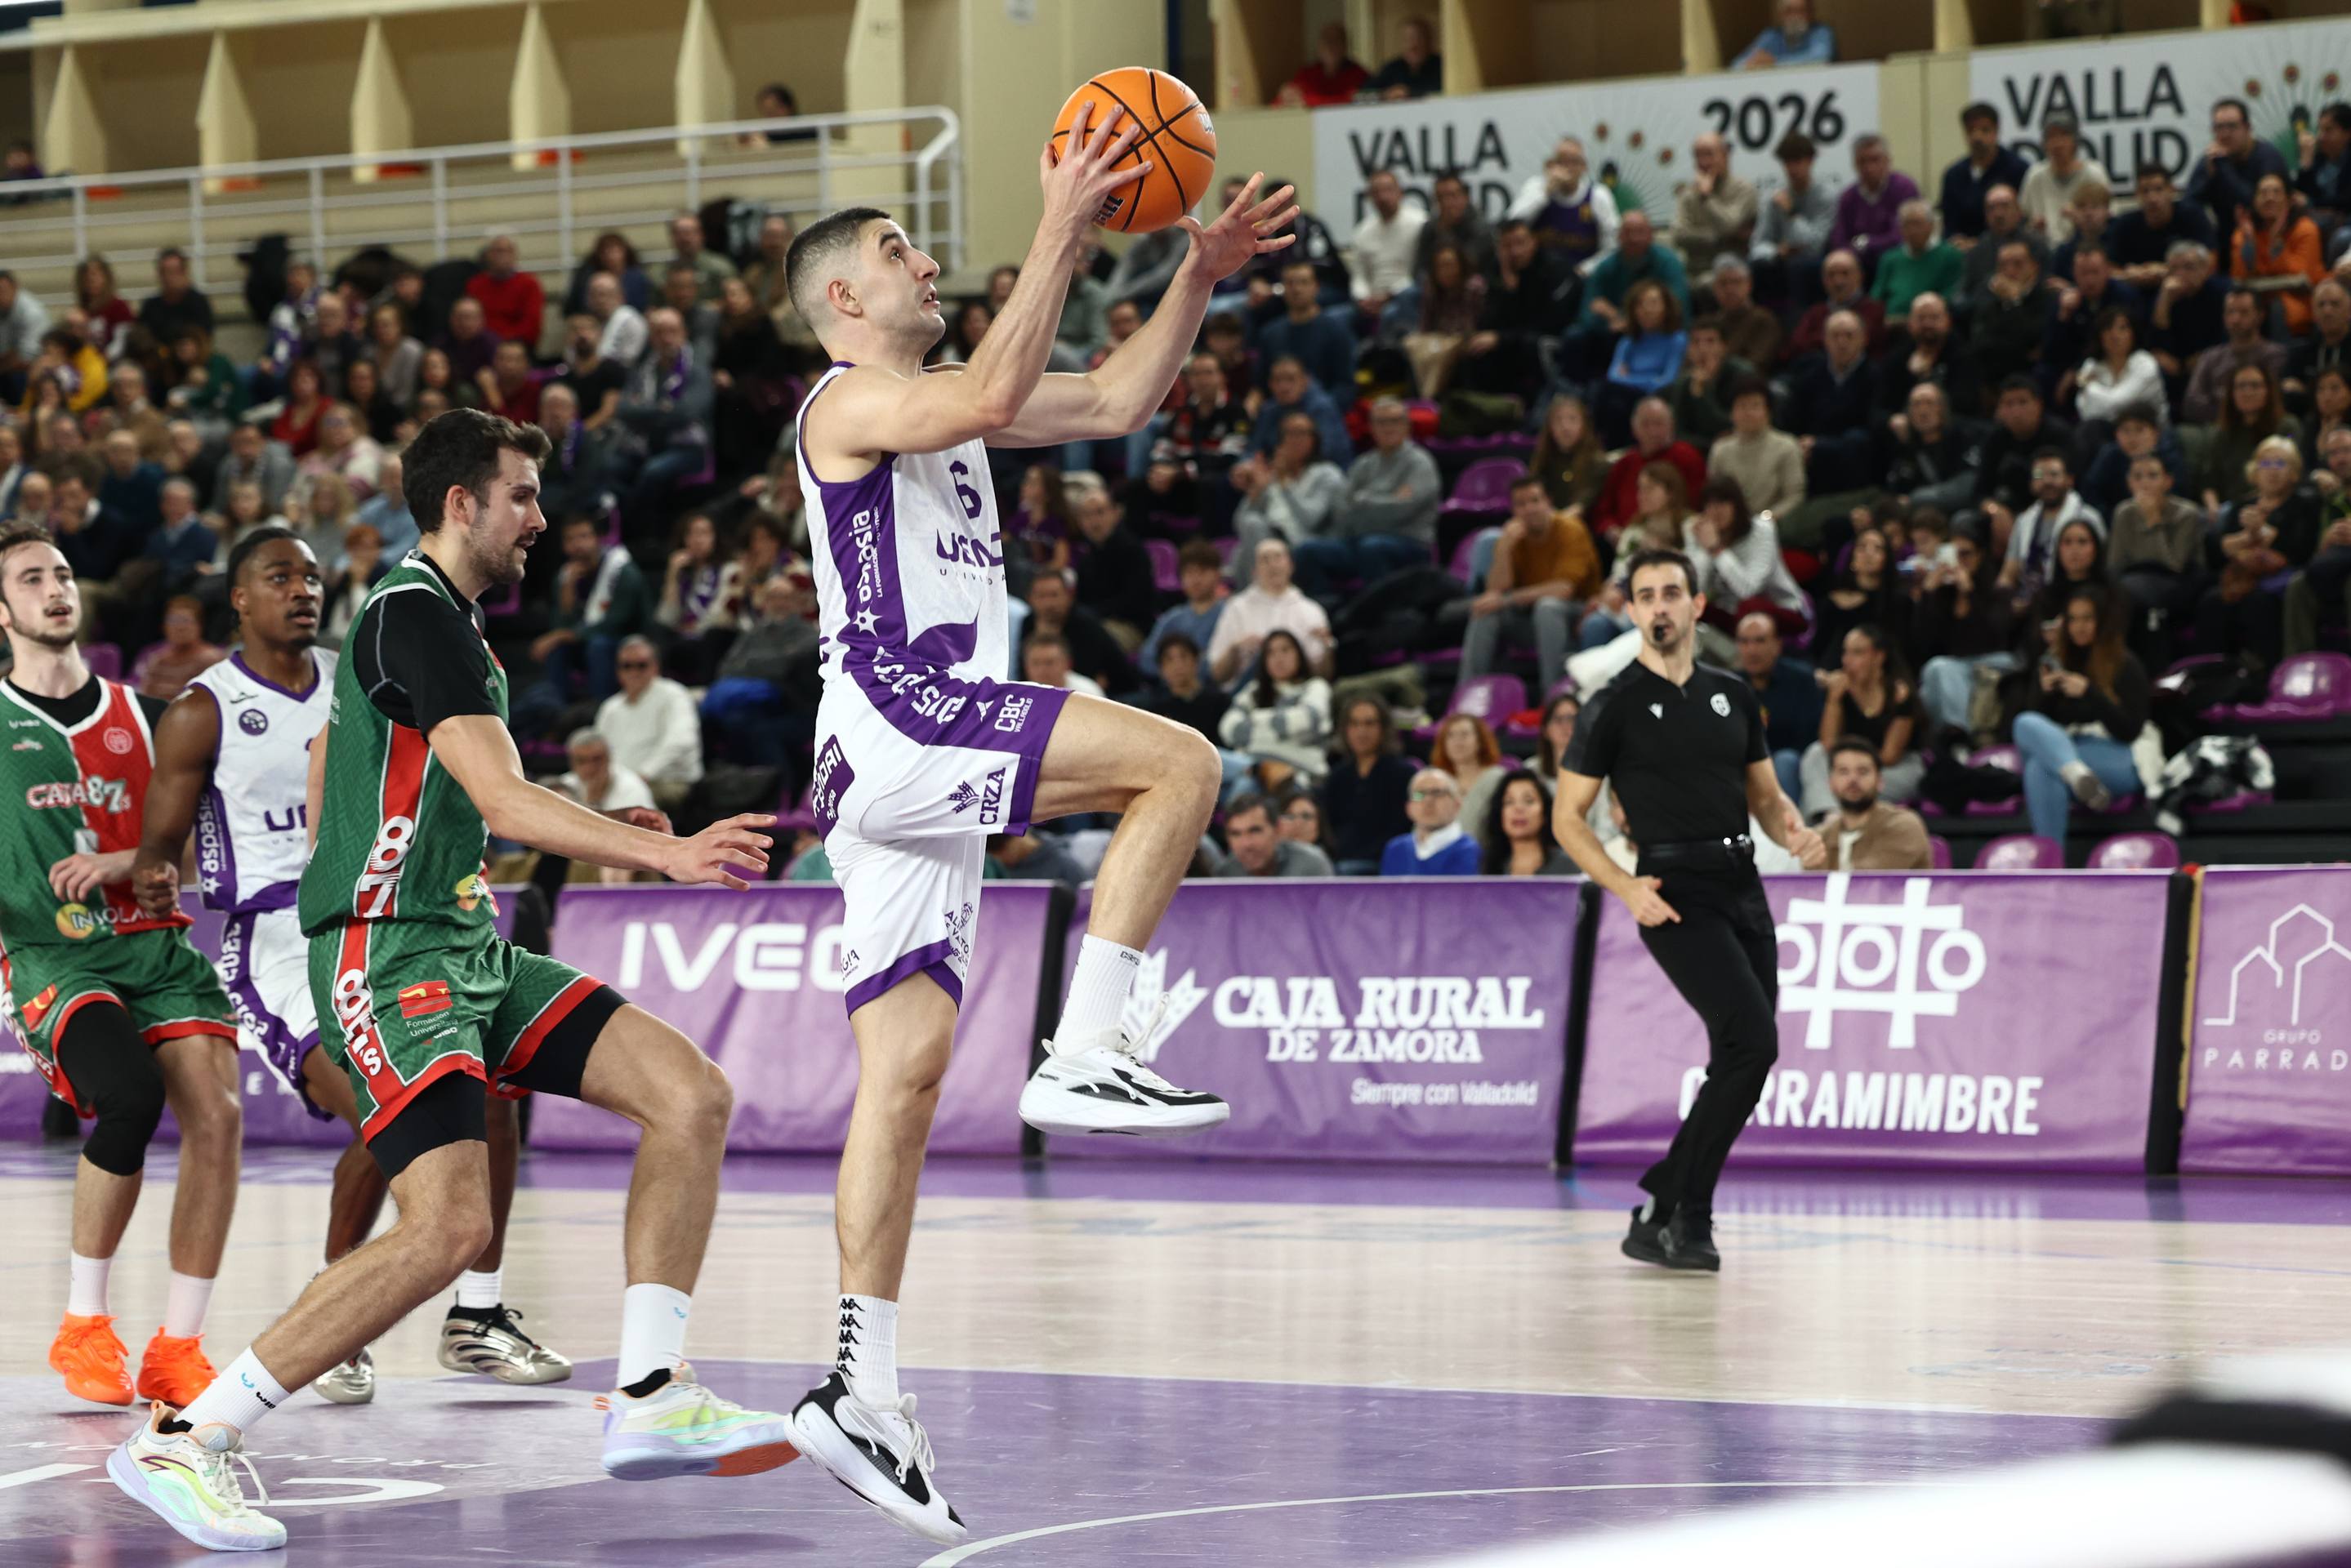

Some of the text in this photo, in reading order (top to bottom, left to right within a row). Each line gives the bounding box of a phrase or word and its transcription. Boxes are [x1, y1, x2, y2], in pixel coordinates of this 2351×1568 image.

[1702, 90, 1845, 150] 2026
[2004, 62, 2185, 129] VALLA
[1349, 118, 1509, 177] VALLA
[949, 461, 982, 519] 6
[994, 694, 1026, 733] CBC
[1014, 697, 1033, 733] VALLADOLID
[980, 767, 1006, 825] CRZA
[71, 907, 152, 929] INSOLA
[618, 923, 844, 992] IVE
[1213, 977, 1544, 1030] CAJA RURAL
[1268, 1029, 1483, 1062] DE ZAMORA
[1678, 1066, 2043, 1136] CRRAMIMBRE
